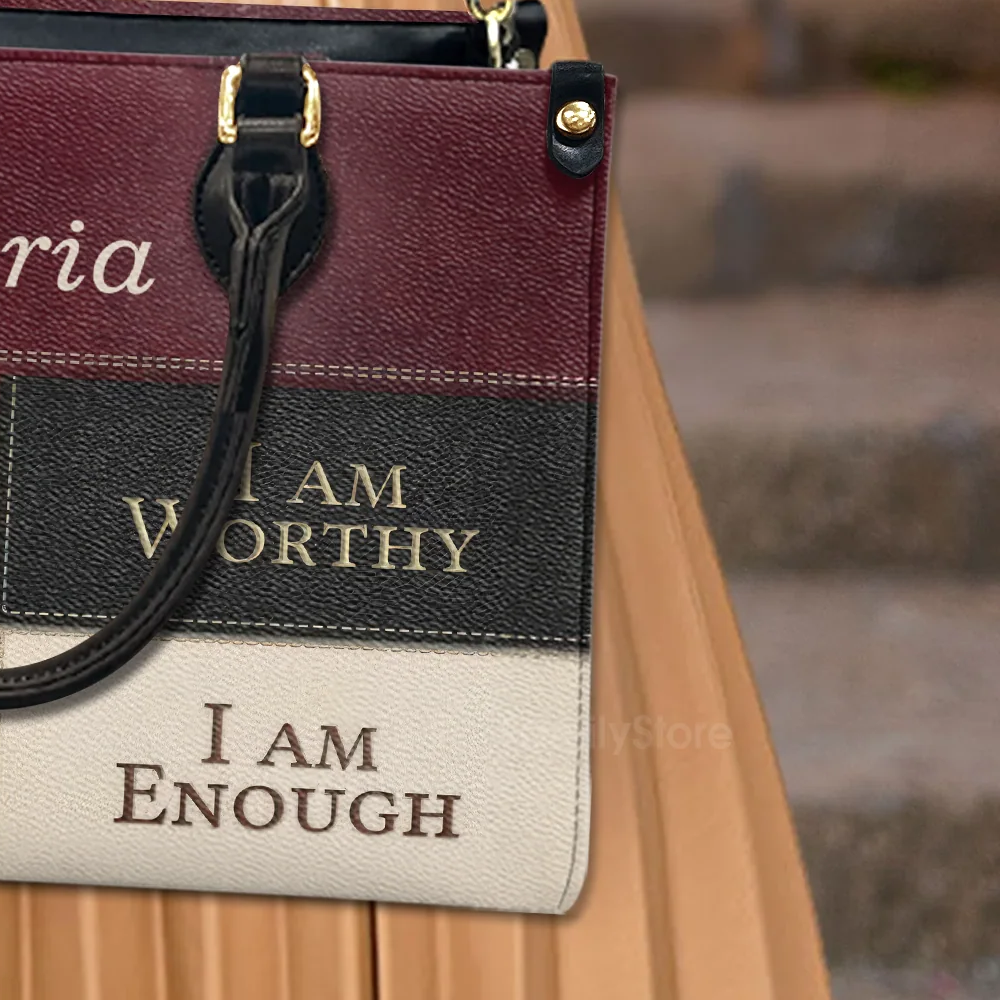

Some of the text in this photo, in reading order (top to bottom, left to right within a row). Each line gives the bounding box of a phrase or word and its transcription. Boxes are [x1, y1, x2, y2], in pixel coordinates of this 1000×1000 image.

[286, 460, 407, 509] AM
[122, 496, 480, 573] WORTHY
[201, 702, 378, 772] I AM
[113, 762, 462, 838] ENOUGH
